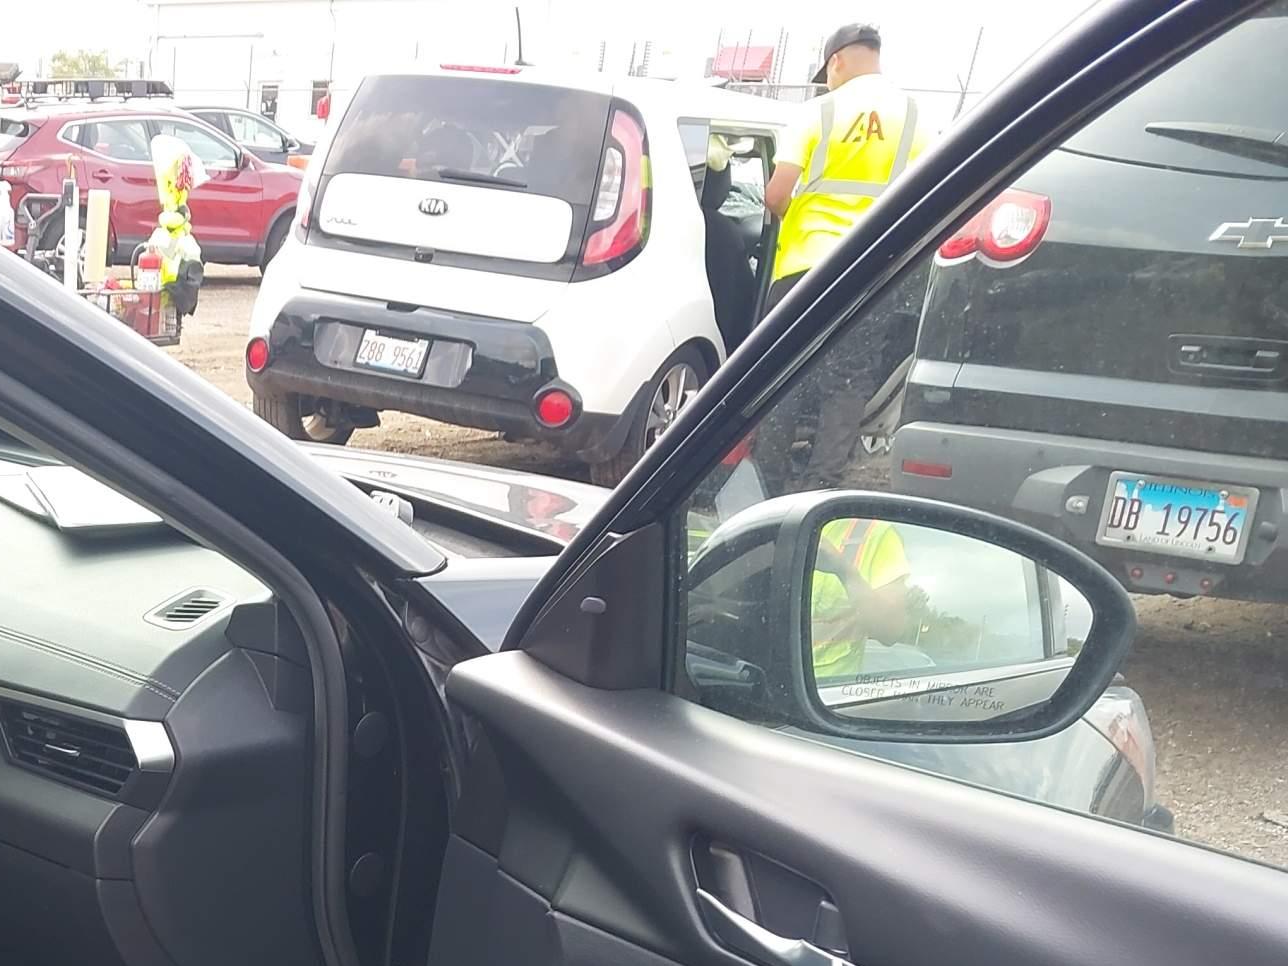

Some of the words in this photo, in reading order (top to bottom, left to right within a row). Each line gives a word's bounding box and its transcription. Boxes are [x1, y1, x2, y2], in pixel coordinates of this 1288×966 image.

[420, 198, 447, 215] KIA
[390, 345, 423, 370] 9561
[1107, 496, 1143, 531] DB
[1156, 503, 1240, 545] 19756
[841, 685, 885, 698] CLOSER
[960, 697, 1005, 710] APPEAR
[855, 674, 902, 688] OBJECTS
[909, 679, 921, 689] IN
[974, 686, 996, 698] ARE
